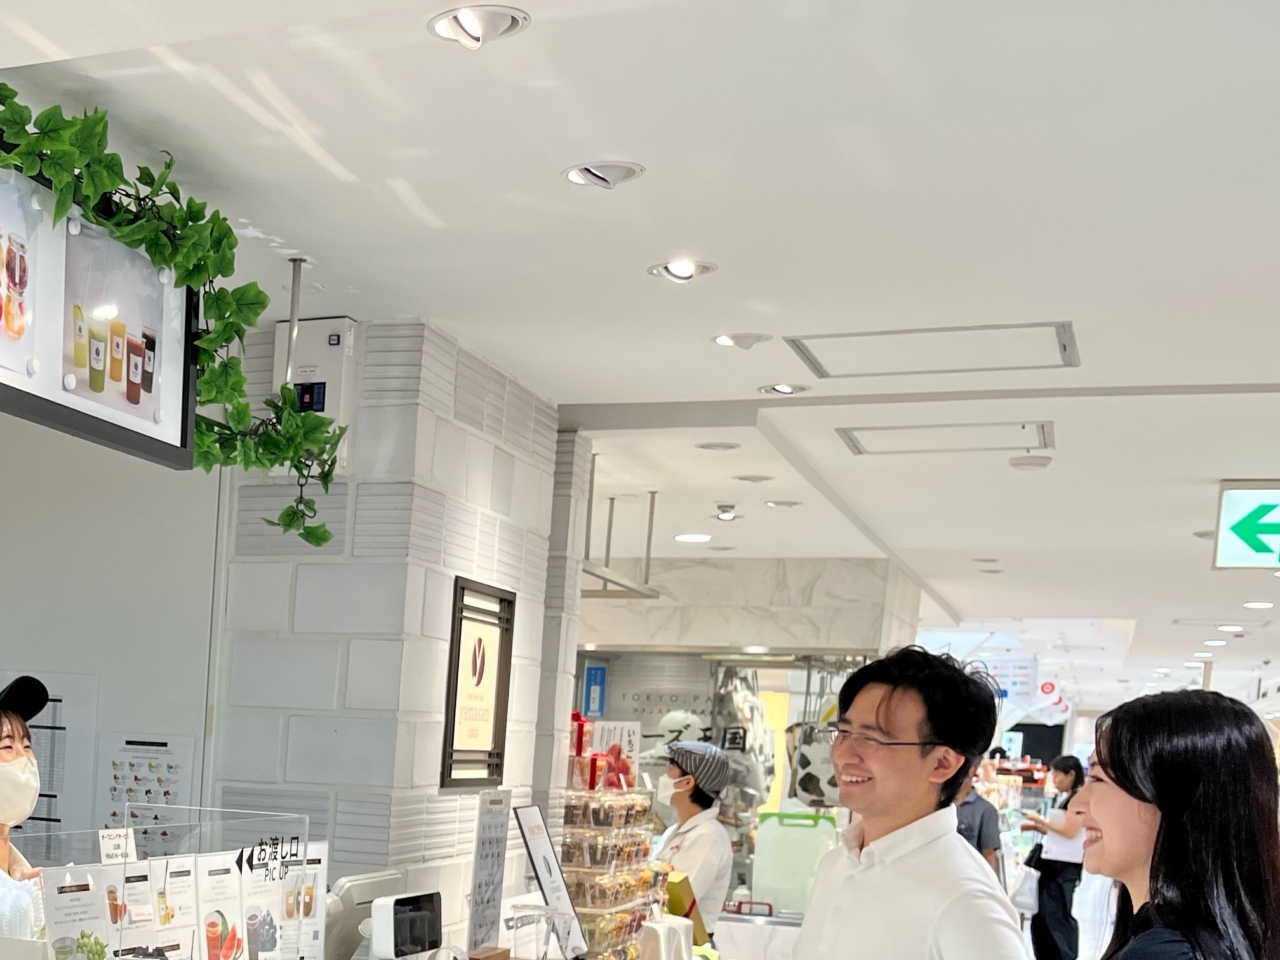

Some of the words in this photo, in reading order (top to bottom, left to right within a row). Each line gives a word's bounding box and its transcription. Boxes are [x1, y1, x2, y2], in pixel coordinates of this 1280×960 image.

[257, 835, 299, 862] お渡し口
[279, 866, 289, 880] UP
